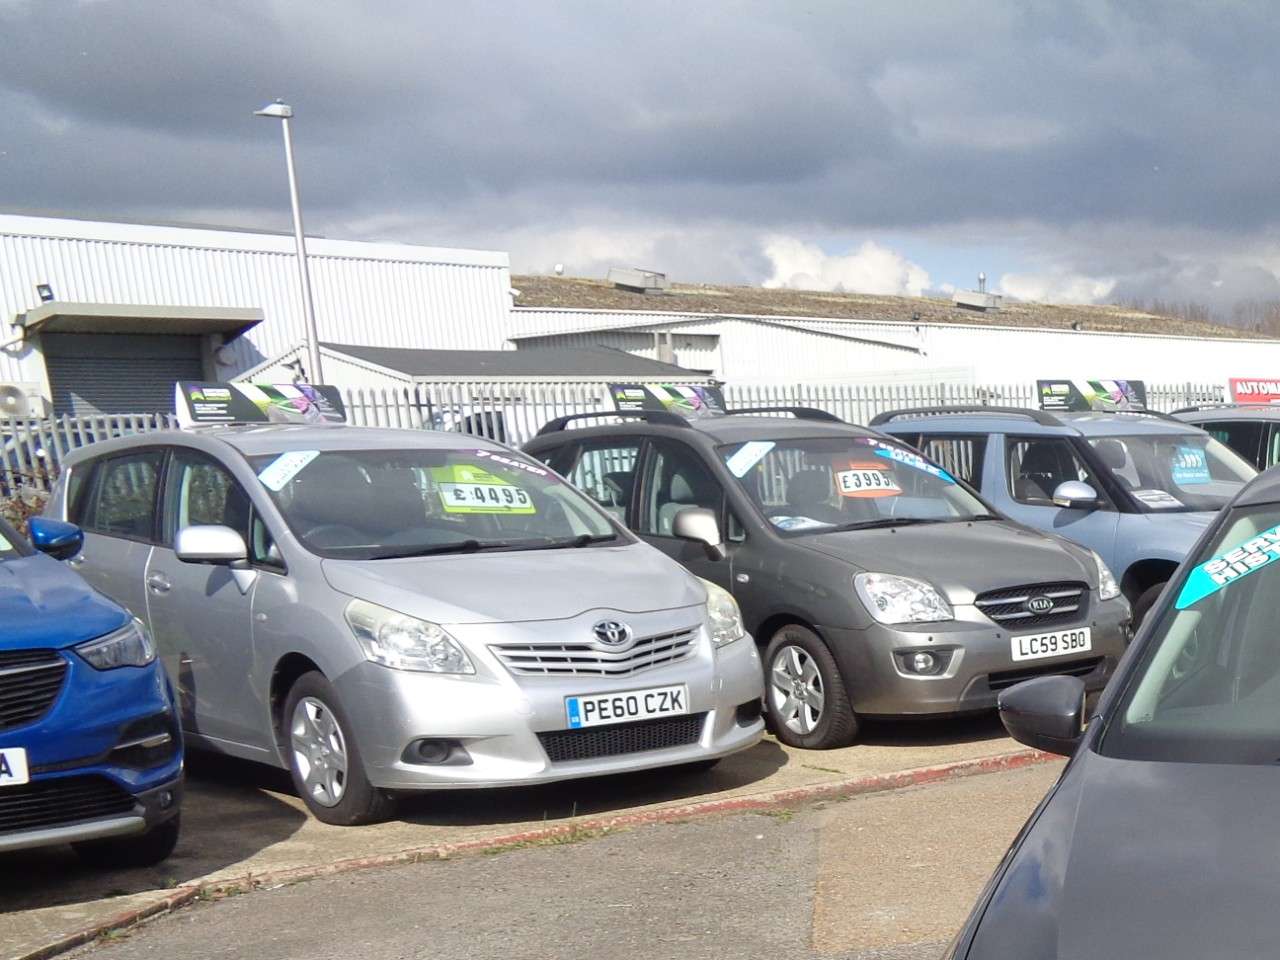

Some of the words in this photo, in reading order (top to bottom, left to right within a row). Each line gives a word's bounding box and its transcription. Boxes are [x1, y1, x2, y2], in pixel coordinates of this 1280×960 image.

[842, 472, 890, 489] £3995
[1018, 635, 1058, 657] LC59
[583, 696, 639, 722] PE60
[644, 689, 683, 714] CZK
